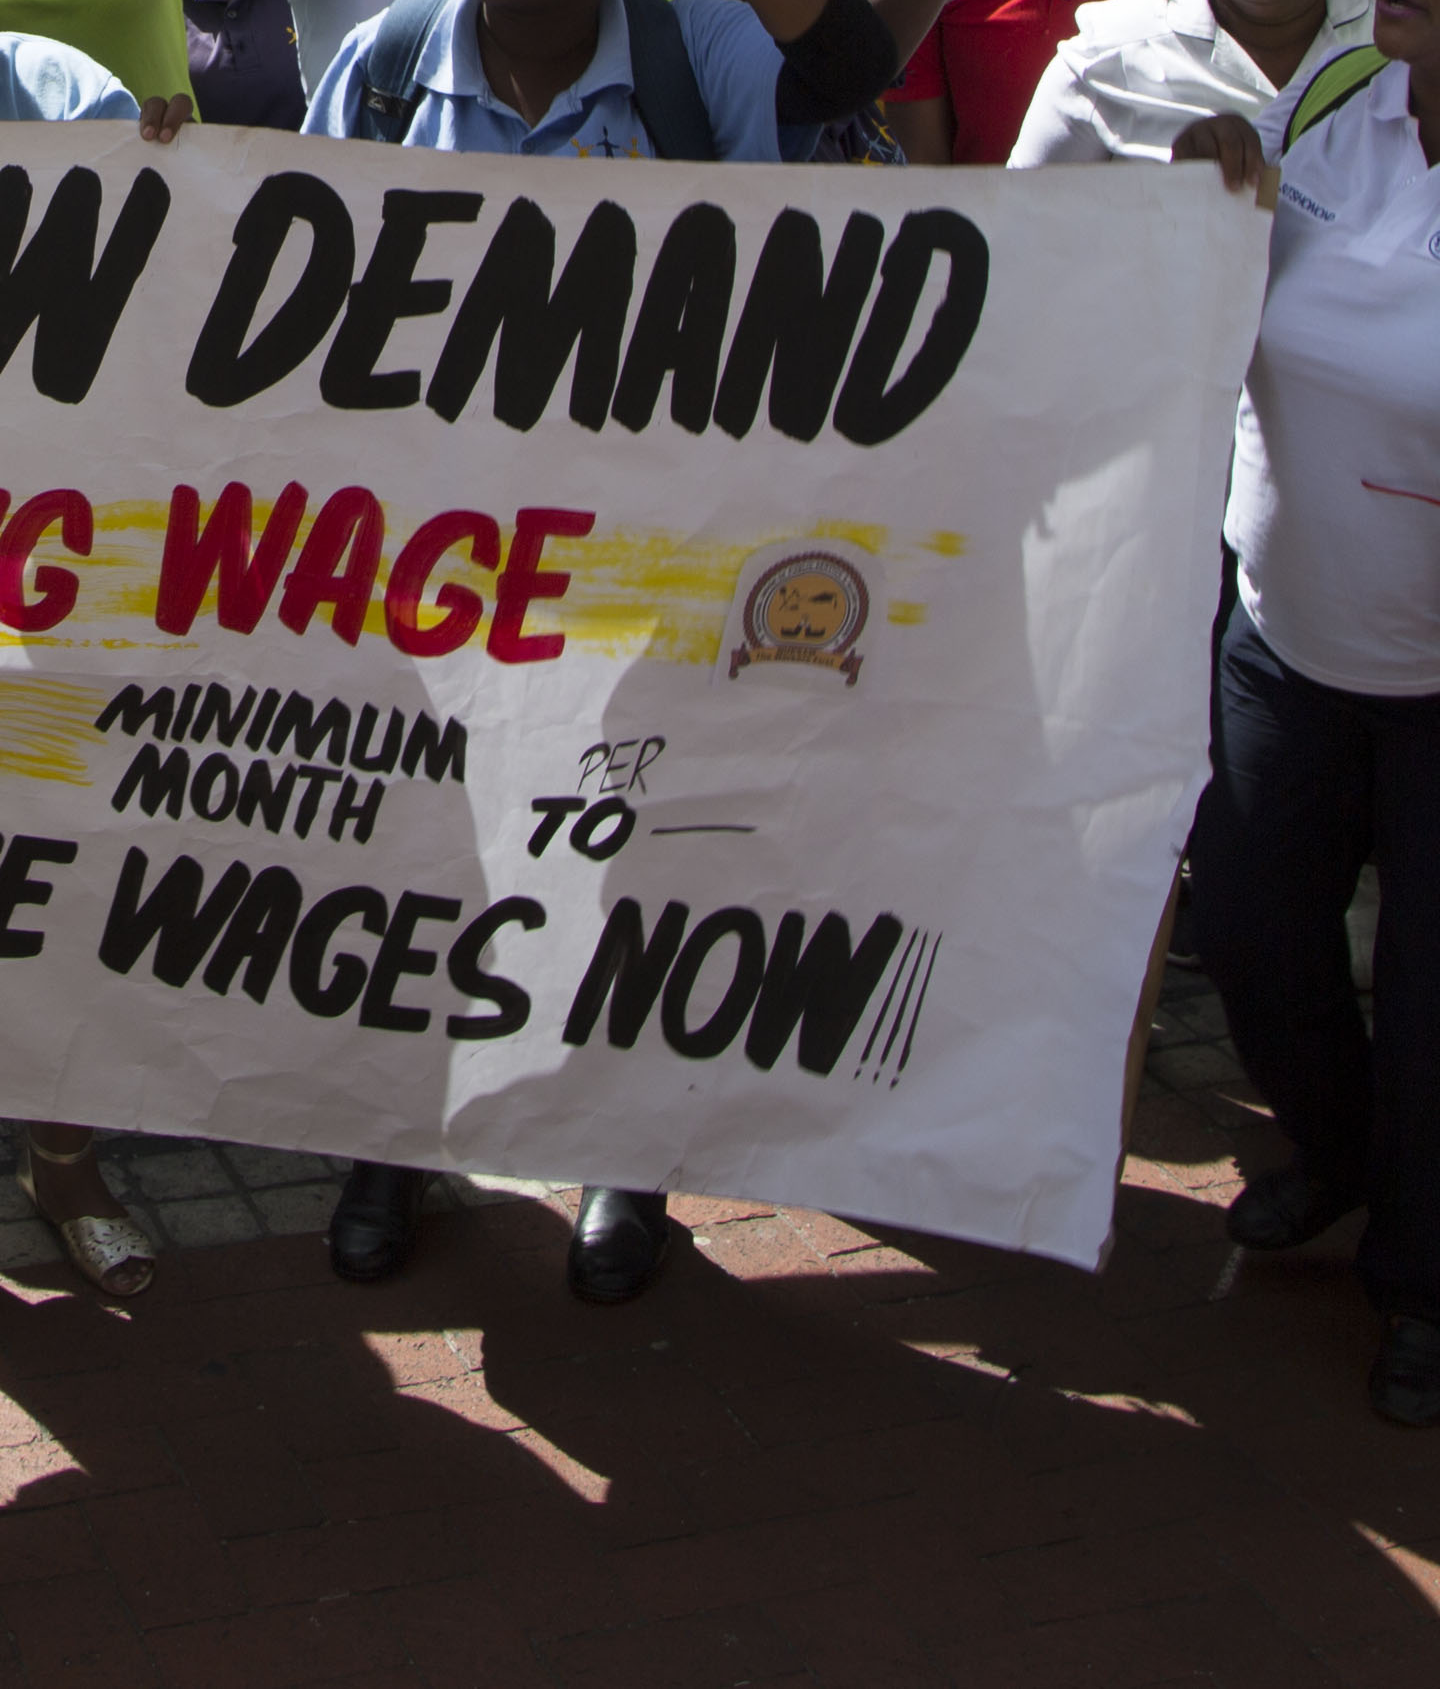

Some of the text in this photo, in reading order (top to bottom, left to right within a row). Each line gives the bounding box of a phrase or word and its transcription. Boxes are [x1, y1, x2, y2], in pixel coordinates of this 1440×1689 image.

[185, 170, 990, 447] DEMAND
[153, 480, 598, 666] WAGE
[95, 682, 468, 784] MINIMUM
[110, 742, 638, 863] MONTH TO
[576, 734, 668, 796] PER
[97, 843, 547, 1041] WAGES
